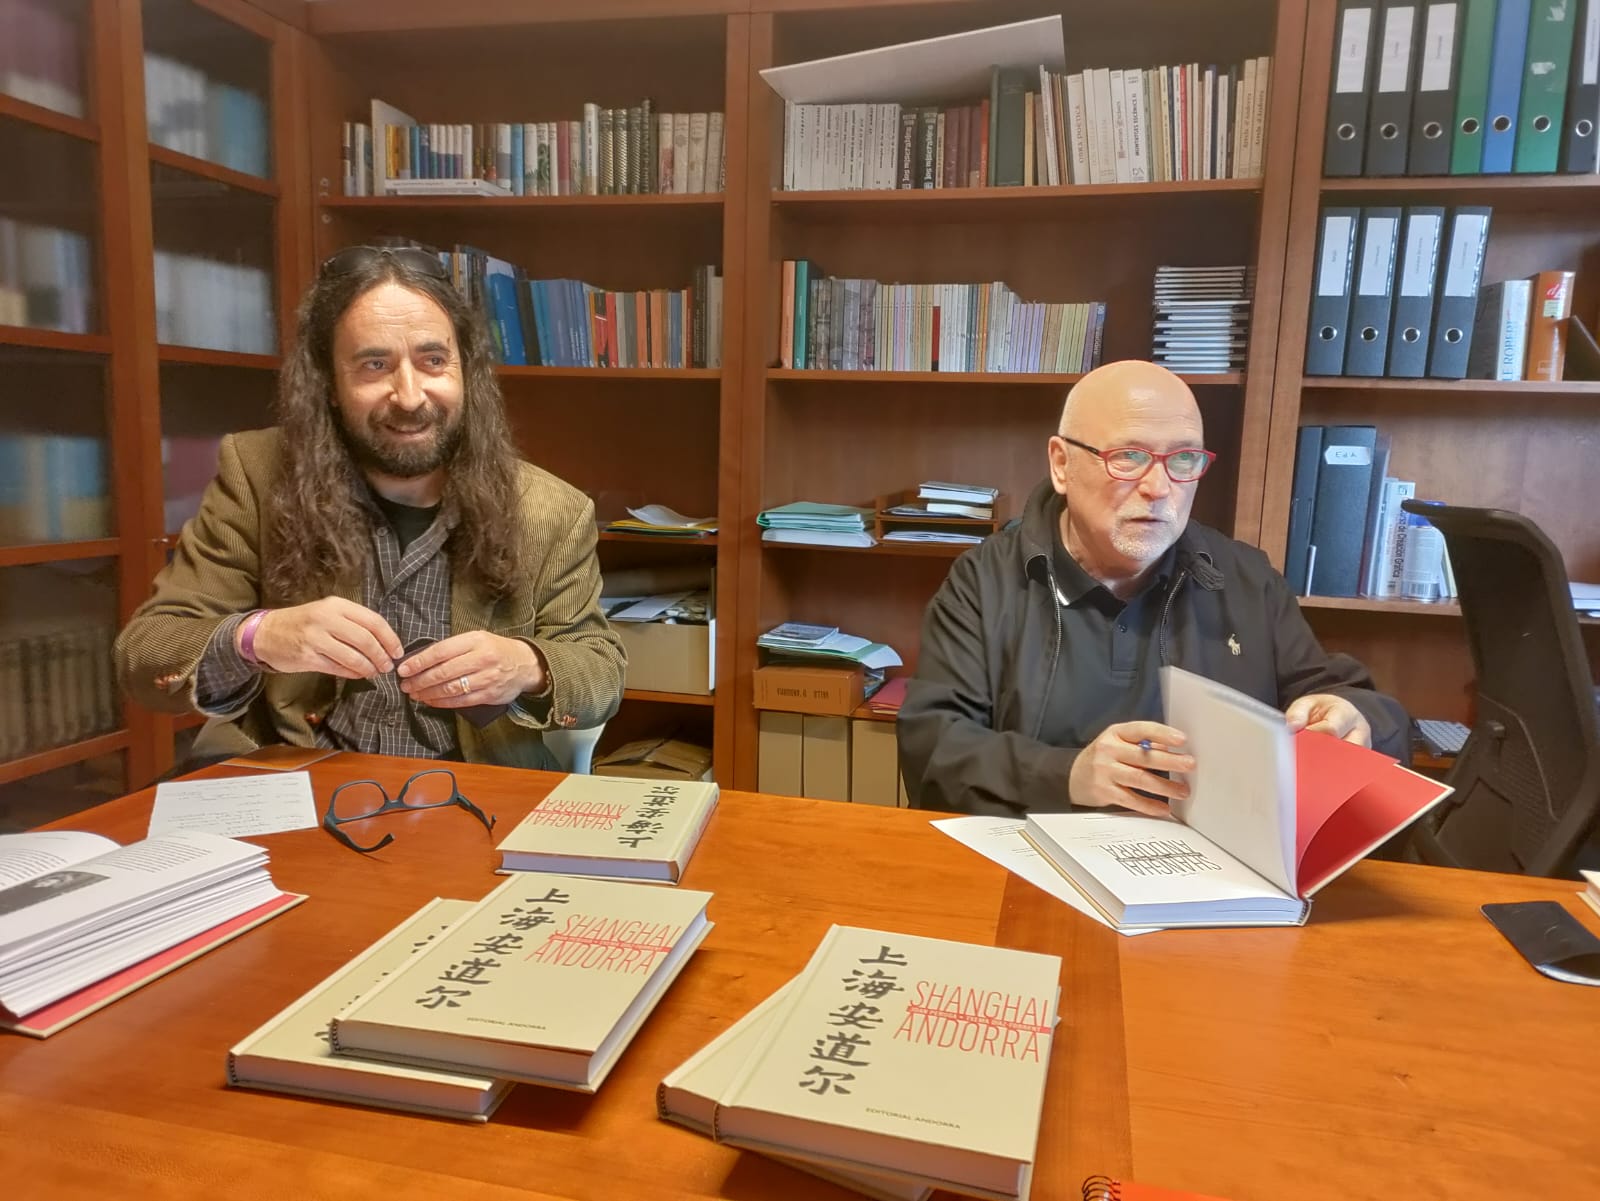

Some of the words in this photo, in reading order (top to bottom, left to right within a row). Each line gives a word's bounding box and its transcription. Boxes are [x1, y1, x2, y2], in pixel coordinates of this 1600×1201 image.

[526, 811, 615, 831] SHANGHAI
[541, 798, 631, 817] ANDORRA
[618, 786, 680, 848] 上海安道尔
[1098, 839, 1197, 861] ANDORRA
[1119, 854, 1223, 877] SHANGHAI
[415, 887, 571, 1010] 上海安道尔
[553, 913, 682, 950] SHANGHAI
[523, 938, 657, 976] ANDORRA
[798, 945, 909, 1096] 上海安道尔
[908, 980, 1050, 1030] SHANGHAI
[892, 1012, 1041, 1063] ANDORRA
[865, 1107, 912, 1121] EDITORIAL
[914, 1116, 962, 1131] ANDORRA
